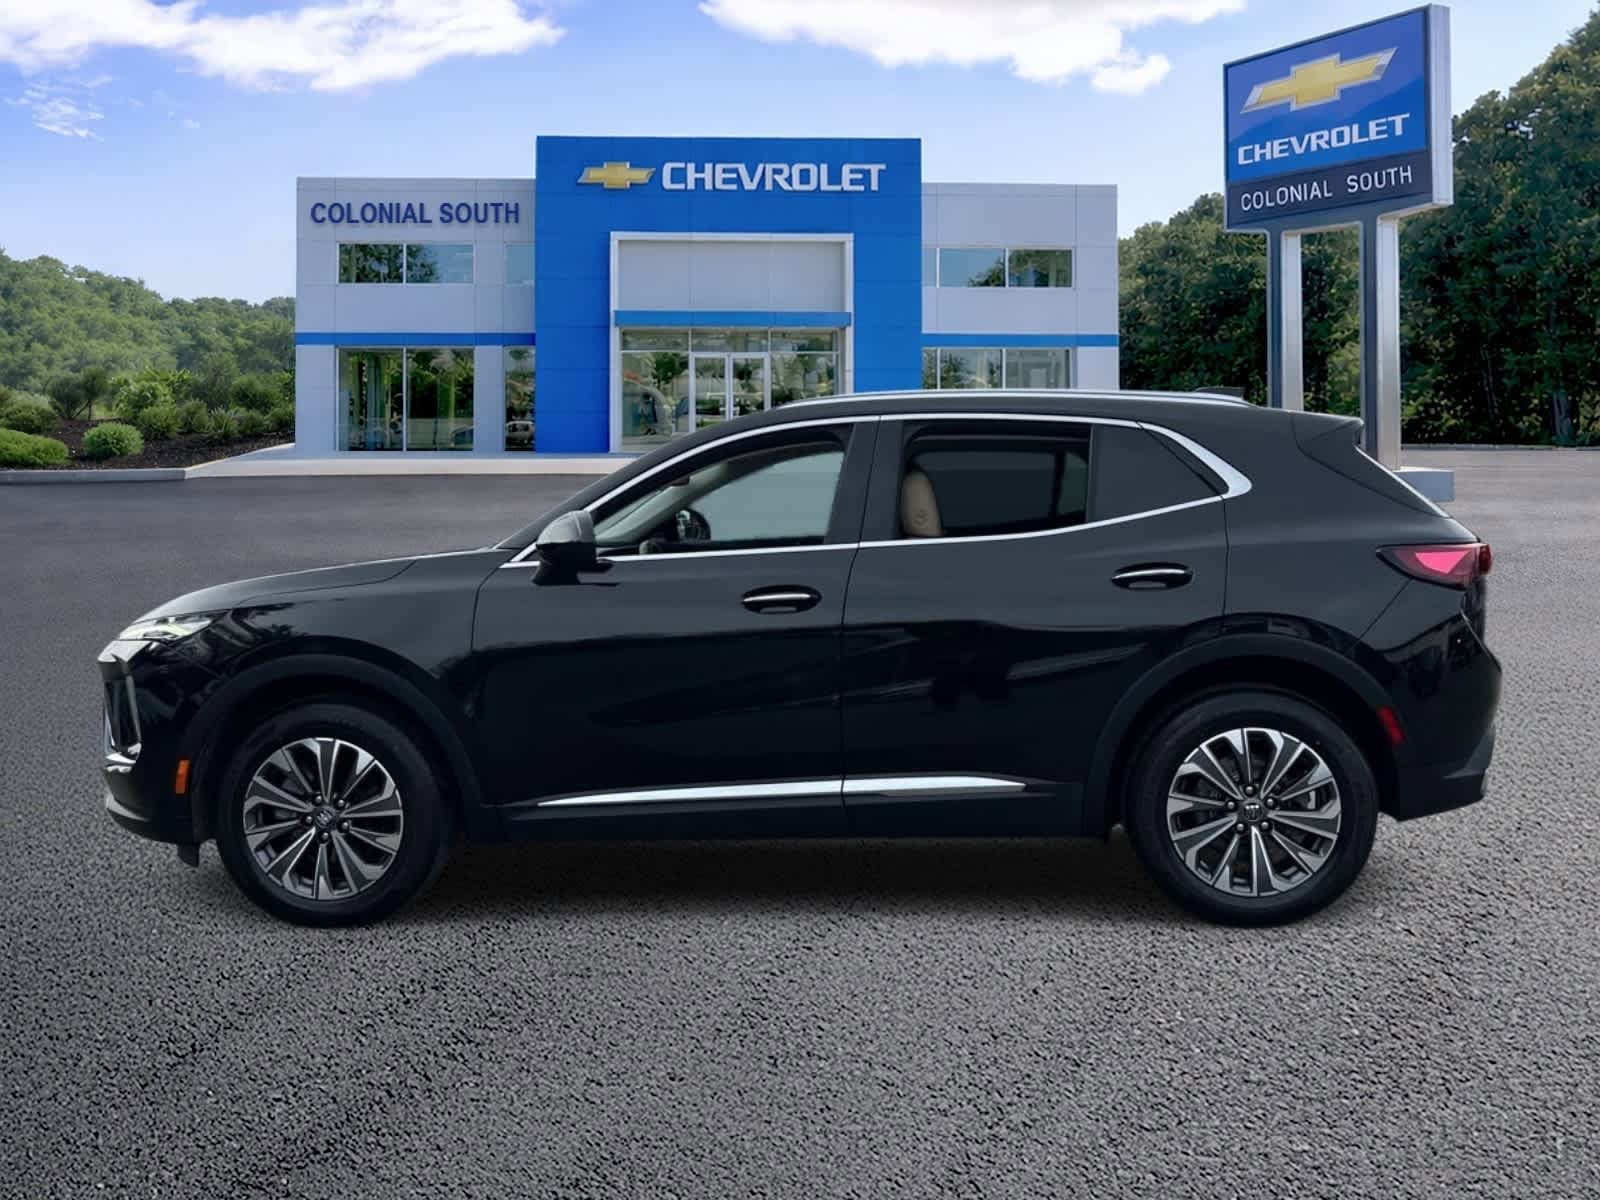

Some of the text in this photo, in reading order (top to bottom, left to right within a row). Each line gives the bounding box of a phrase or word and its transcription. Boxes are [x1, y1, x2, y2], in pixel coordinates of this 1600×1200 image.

[1238, 113, 1410, 165] CHEVROLET
[662, 162, 886, 191] CHEVROLET
[1240, 165, 1412, 211] COLONIAL SOUTH
[311, 203, 519, 224] COLONIAL SOUTH
